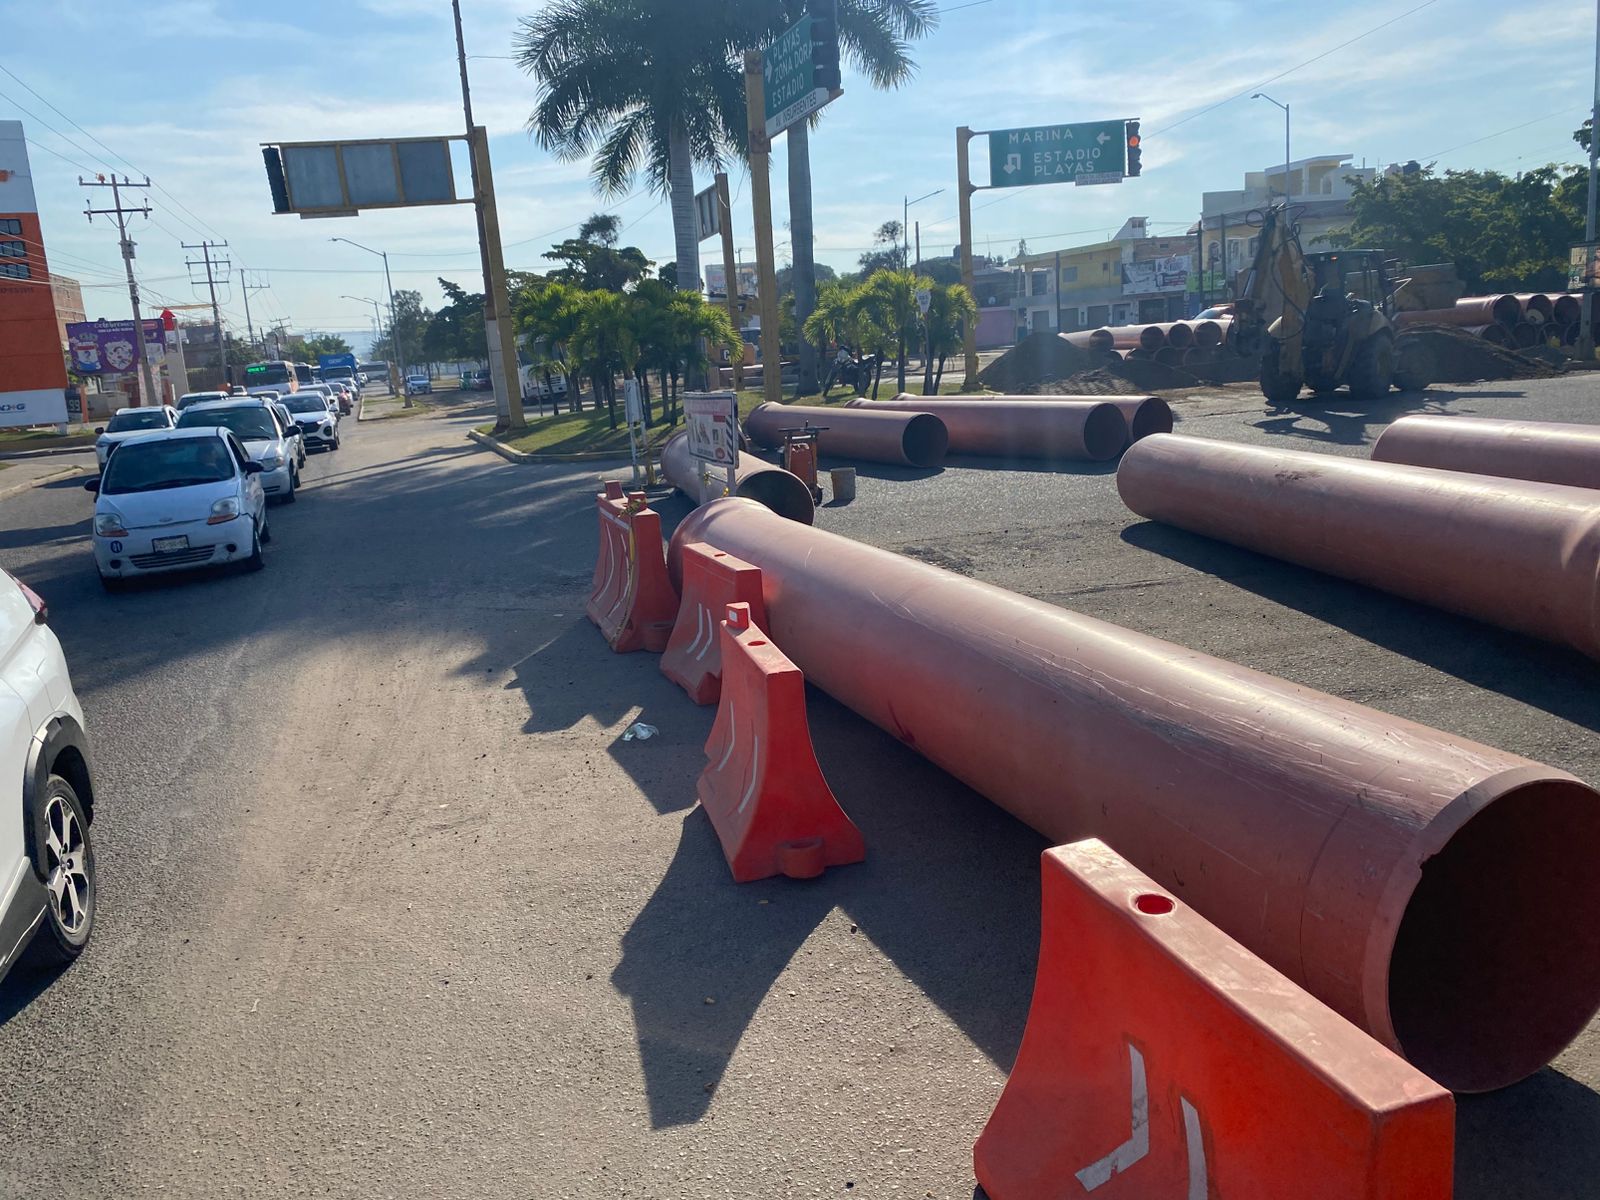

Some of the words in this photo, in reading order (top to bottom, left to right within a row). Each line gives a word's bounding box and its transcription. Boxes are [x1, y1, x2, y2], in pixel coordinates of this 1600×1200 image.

[773, 28, 800, 60] PLAYAS
[775, 57, 793, 85] ZONA
[772, 73, 804, 108] ESTADIO
[1008, 128, 1074, 144] MARINA
[1033, 147, 1101, 163] ESTADIO
[1034, 161, 1095, 177] PLAYAS
